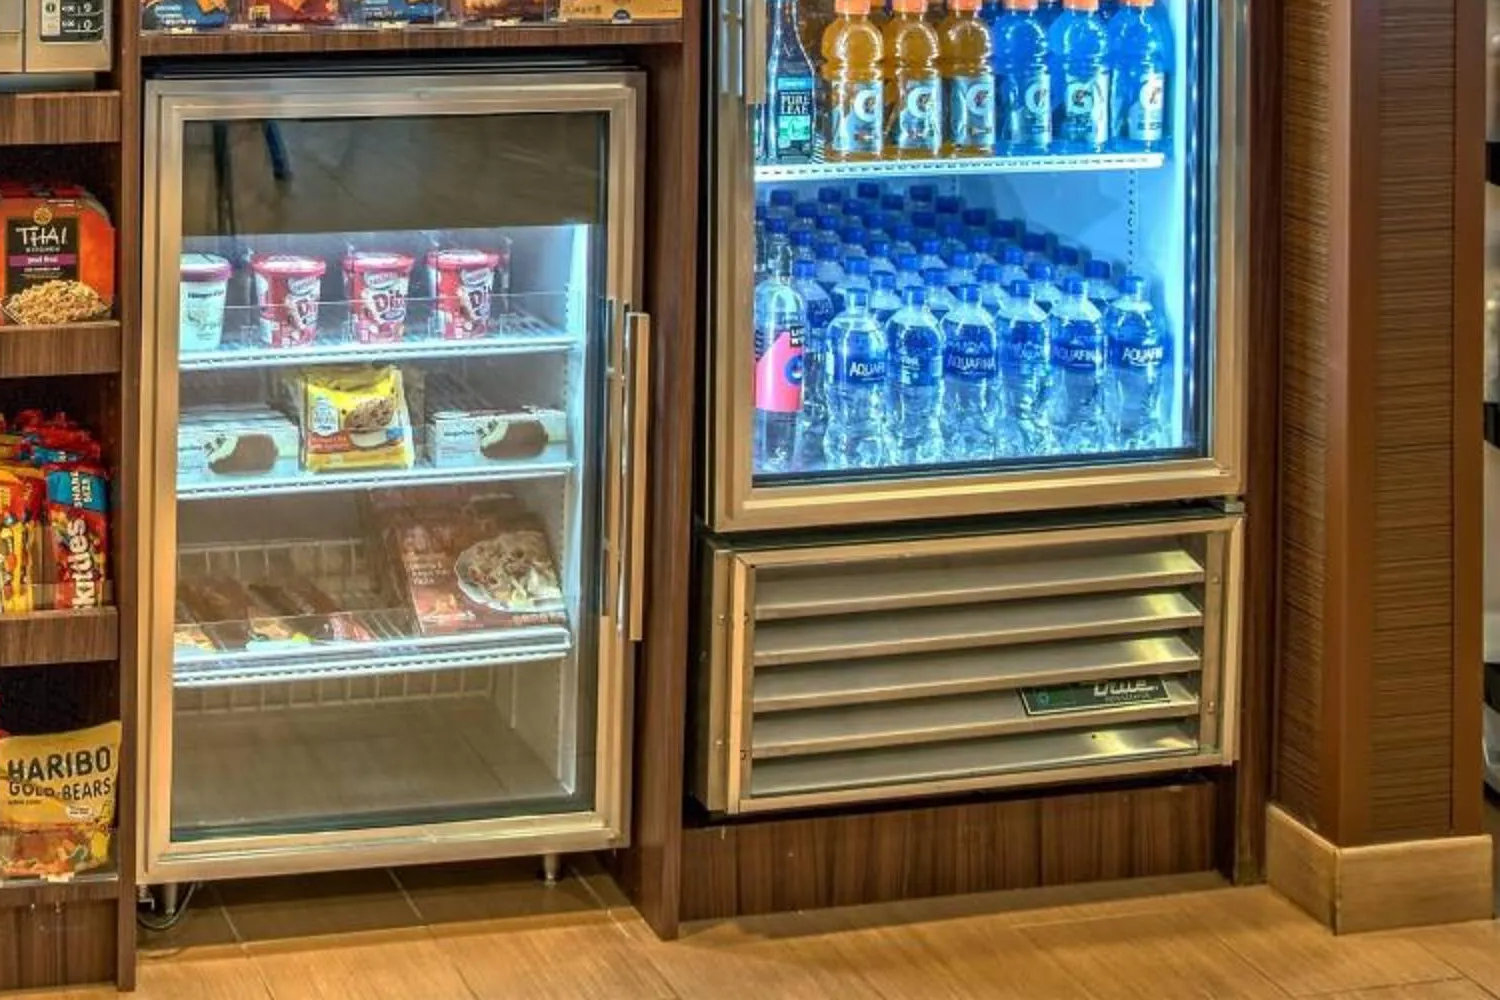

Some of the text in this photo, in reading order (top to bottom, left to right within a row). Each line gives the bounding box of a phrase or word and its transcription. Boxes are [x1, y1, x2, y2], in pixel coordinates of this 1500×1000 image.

[15, 226, 68, 247] THAI
[68, 518, 96, 608] kittles
[7, 746, 112, 783] HARIBO
